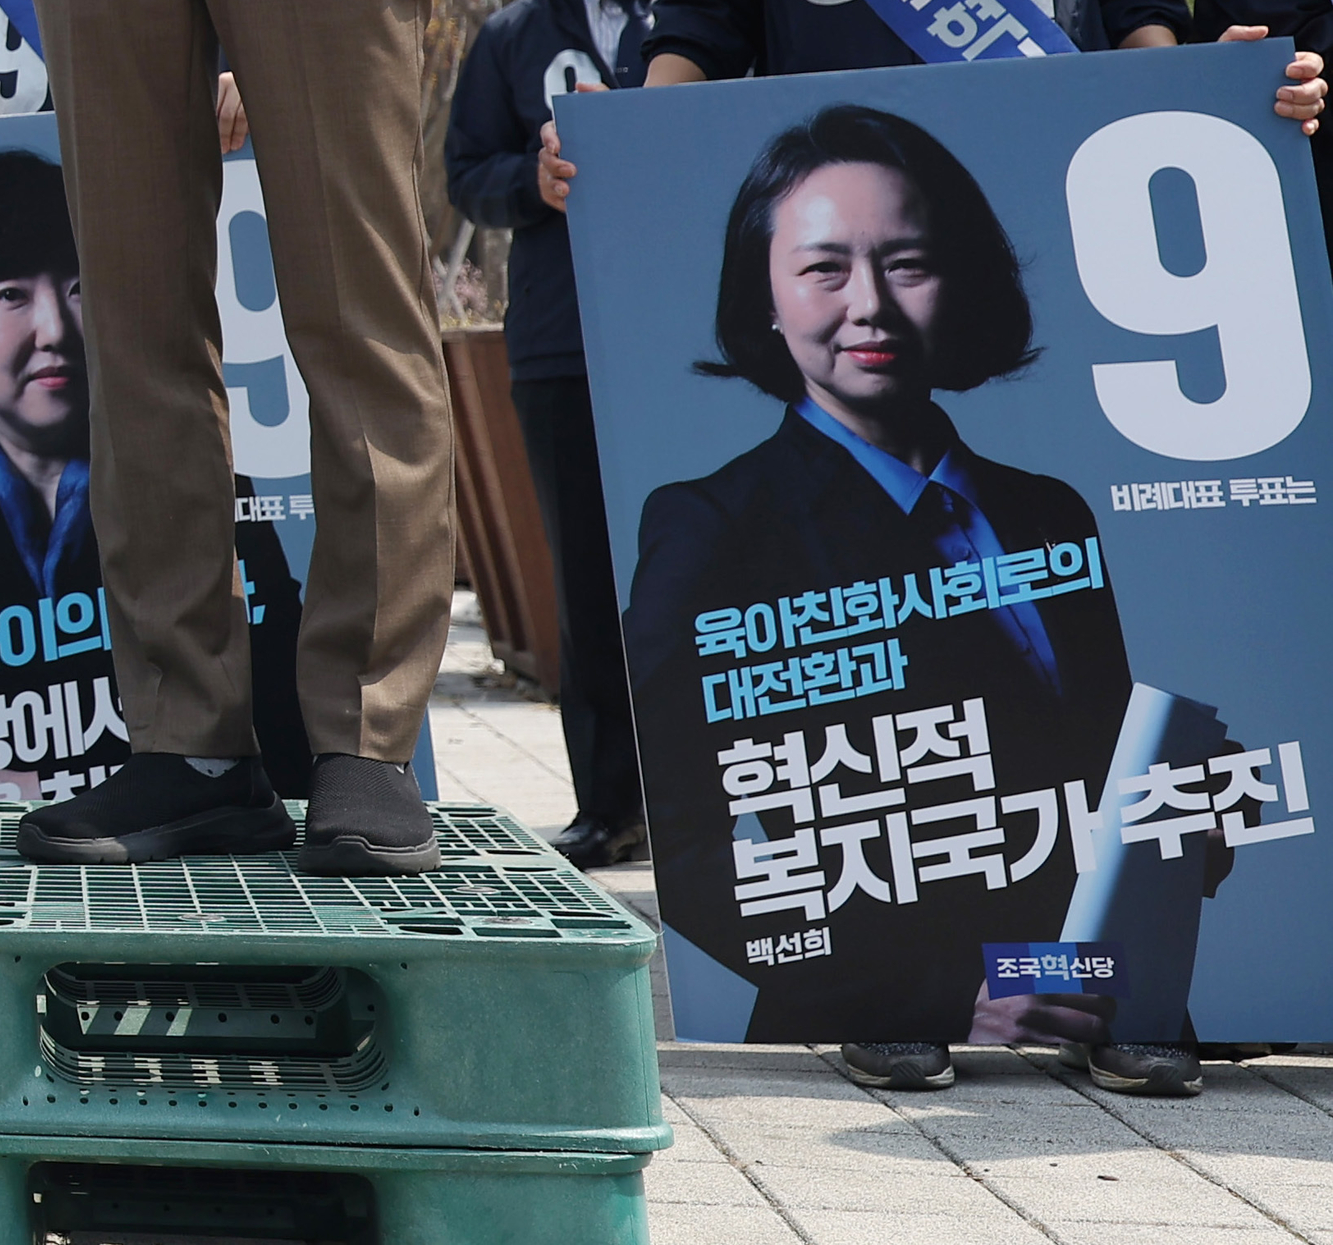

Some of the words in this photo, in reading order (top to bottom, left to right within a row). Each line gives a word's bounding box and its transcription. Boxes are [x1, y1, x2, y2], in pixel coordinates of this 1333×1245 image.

[1065, 110, 1312, 461] 9
[234, 495, 286, 522] 대표
[1111, 480, 1225, 511] 비례대표
[1230, 476, 1317, 507] 투표는
[693, 537, 1105, 657] 육아친화사회로의
[702, 638, 908, 723] 대전환과
[717, 696, 996, 824] 혁신적
[732, 778, 1104, 921] 복지국가
[1117, 741, 1315, 861] 추진
[745, 927, 831, 967] 백선희
[997, 953, 1115, 980] 조국혁신당
